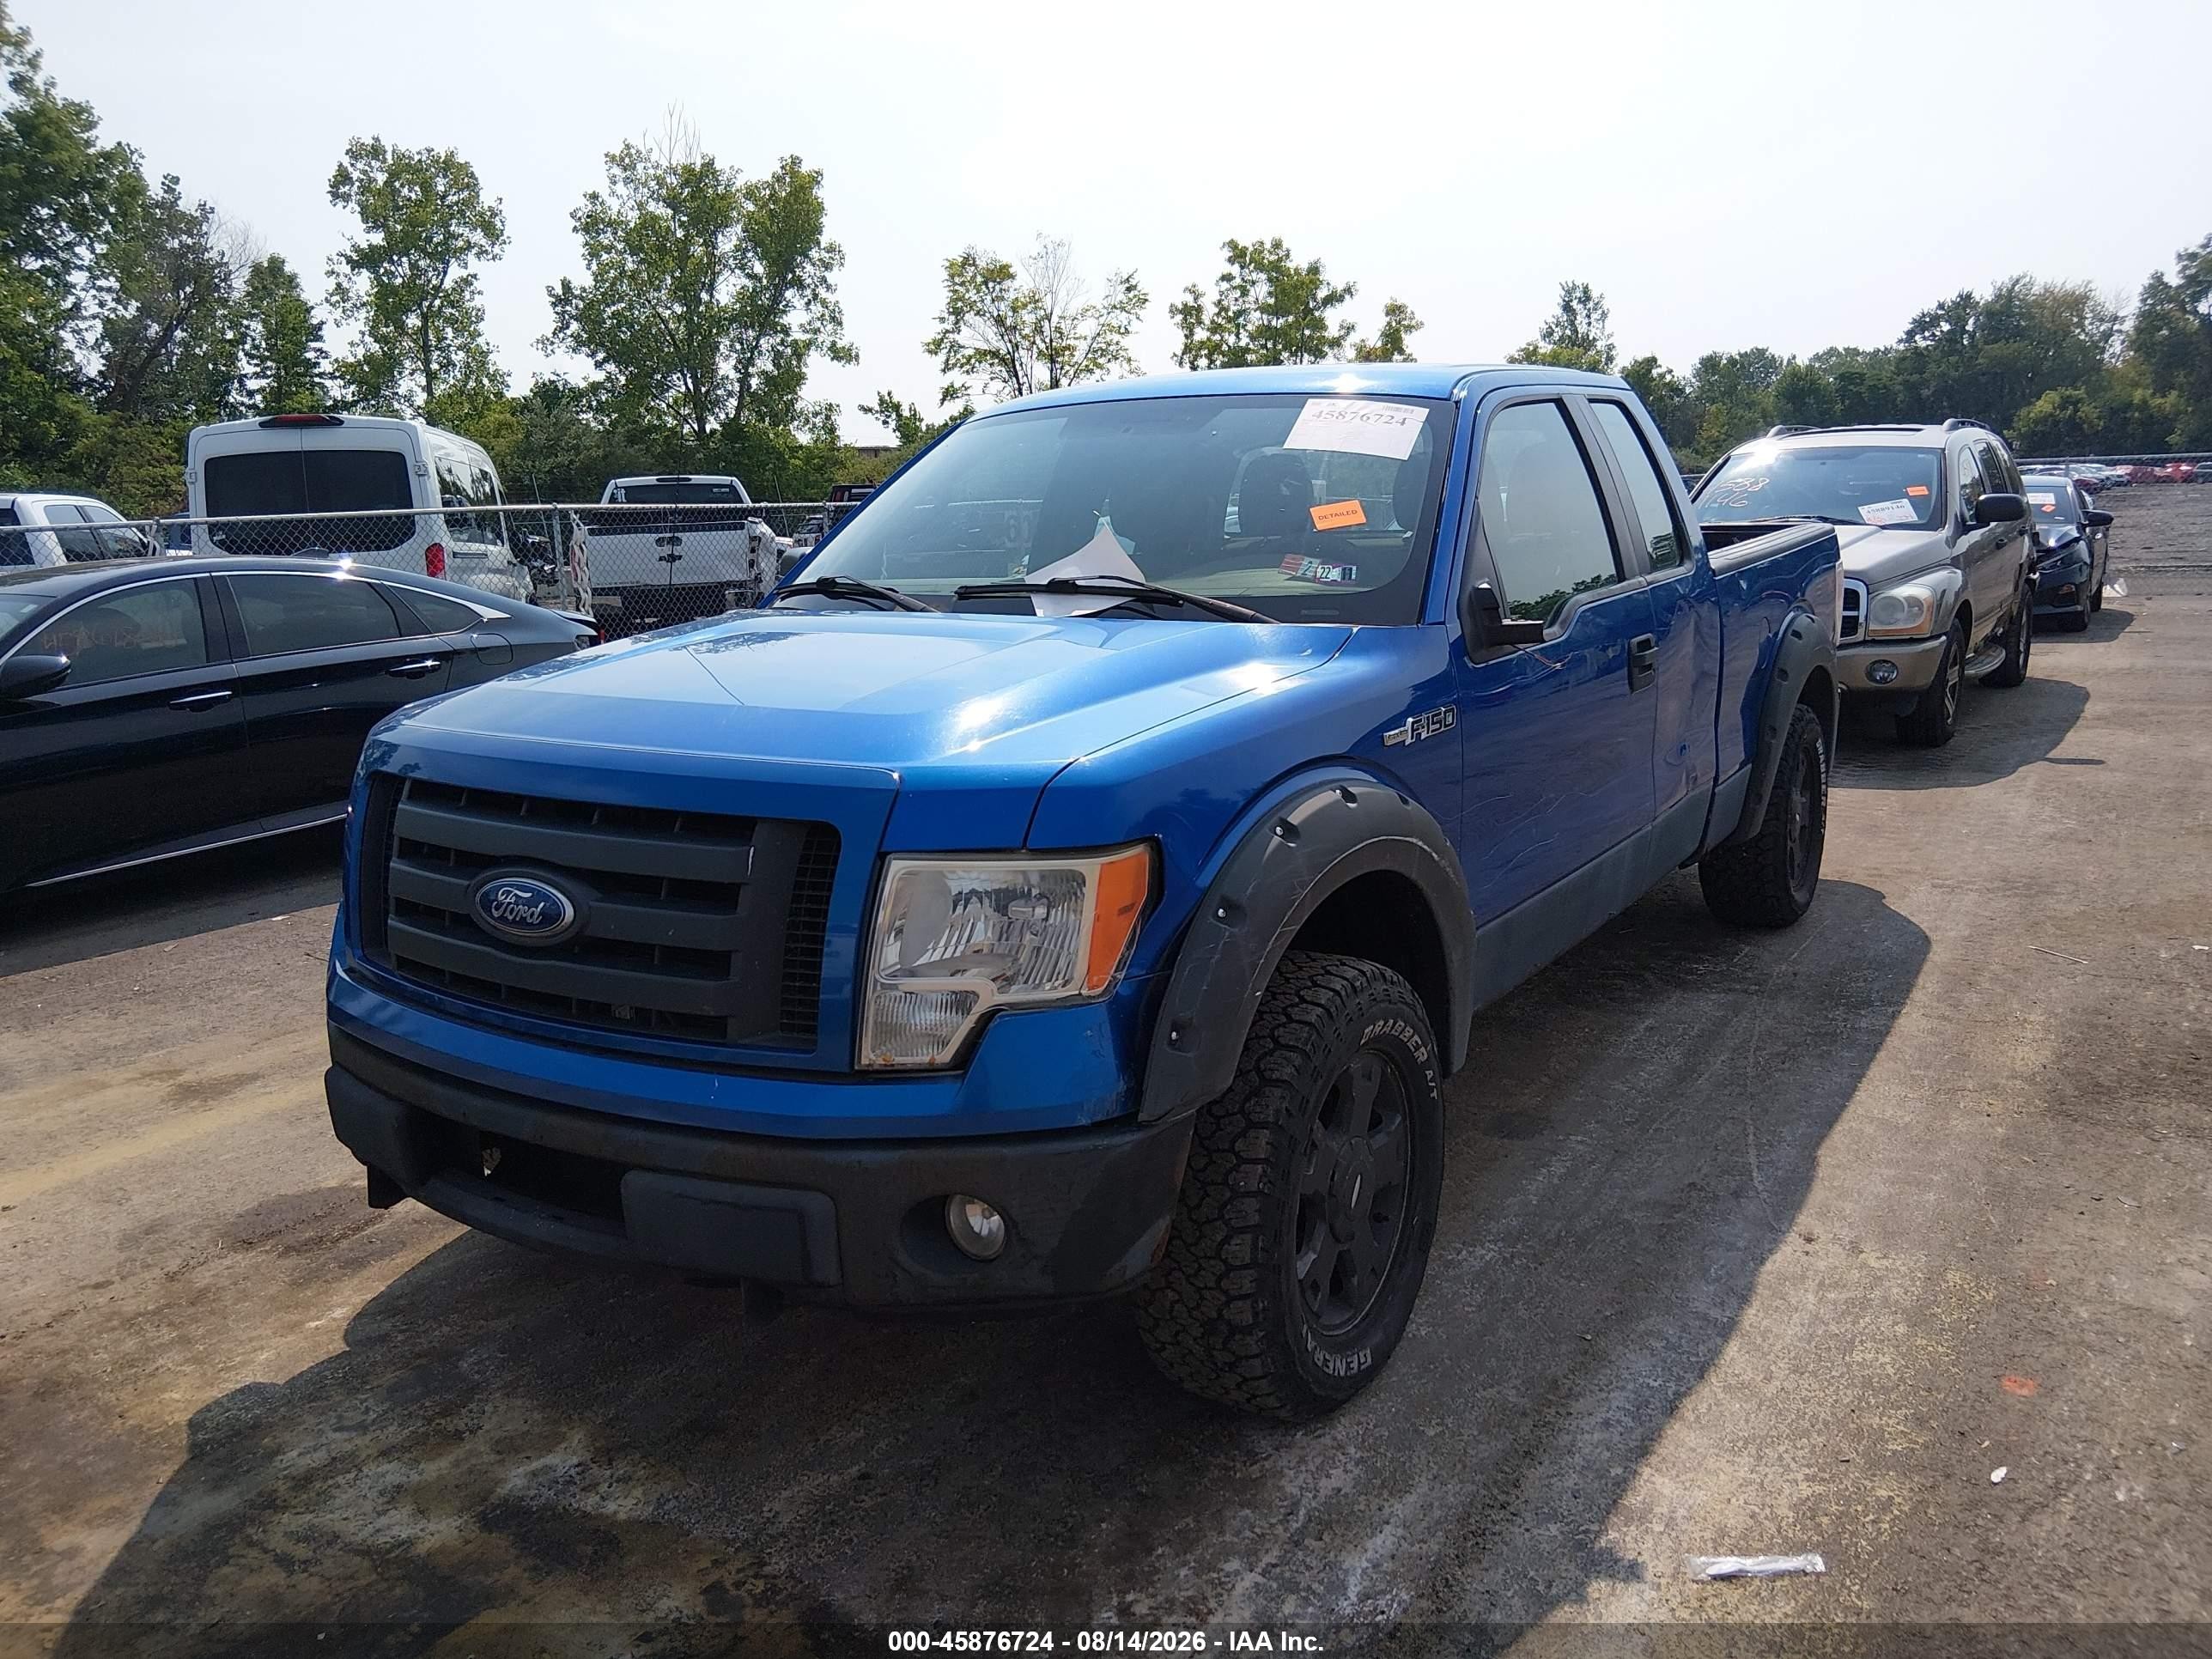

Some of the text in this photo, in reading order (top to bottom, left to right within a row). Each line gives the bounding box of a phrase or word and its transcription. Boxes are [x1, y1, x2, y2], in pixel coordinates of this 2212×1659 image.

[1311, 410, 1408, 427] 45876724
[1317, 509, 1358, 520] DETAILED
[1319, 566, 1332, 580] 22
[490, 886, 545, 925] Ford
[1359, 1017, 1438, 1100] GRABBER A/T
